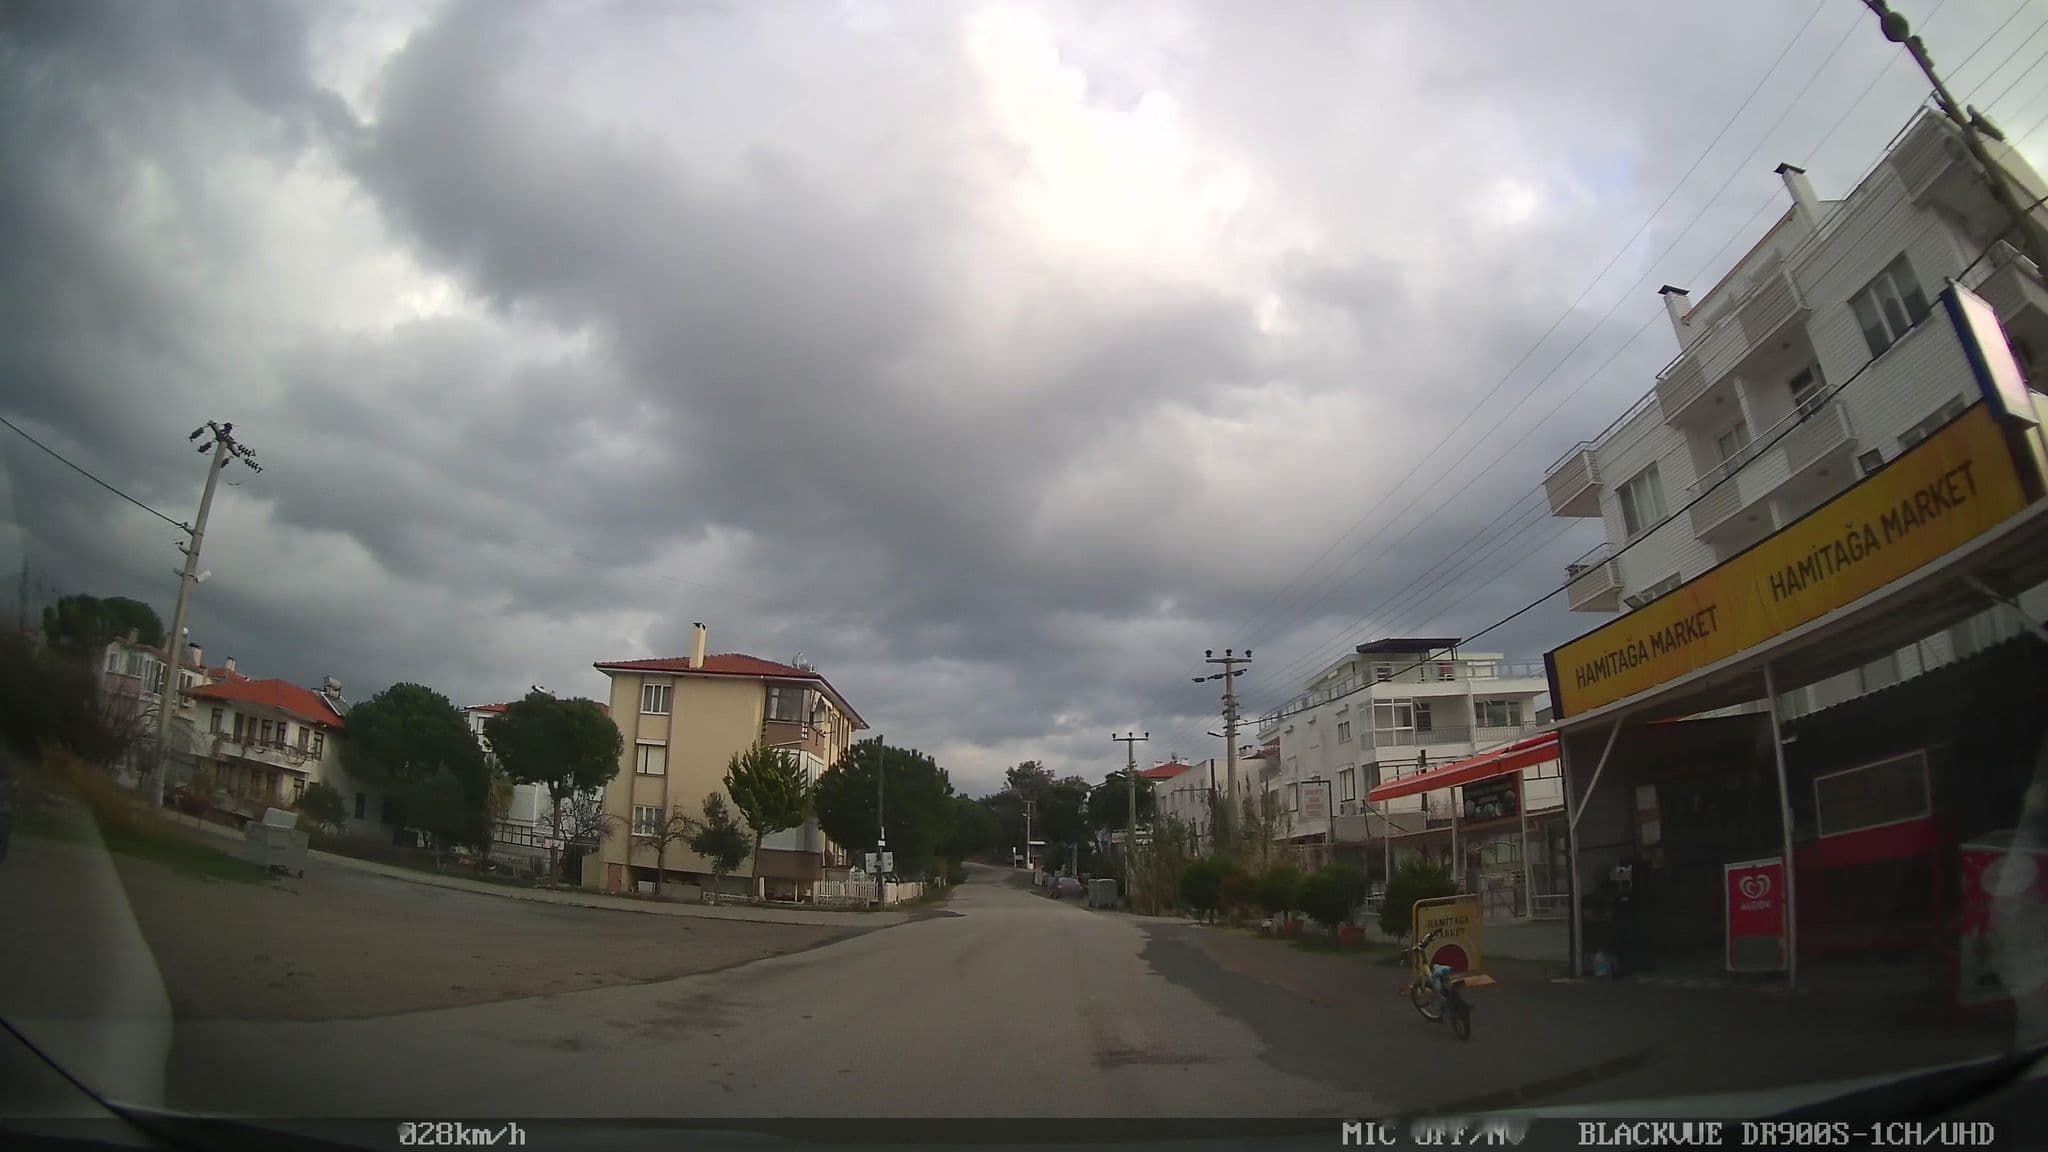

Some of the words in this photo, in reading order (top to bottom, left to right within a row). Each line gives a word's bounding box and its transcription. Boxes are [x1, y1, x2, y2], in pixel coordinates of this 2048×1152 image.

[1770, 522, 1881, 602] HAMİTAĞA
[1880, 459, 1978, 545] MARKET
[1575, 636, 1649, 689] HAMİTAĞA
[1650, 604, 1718, 658] MARKET
